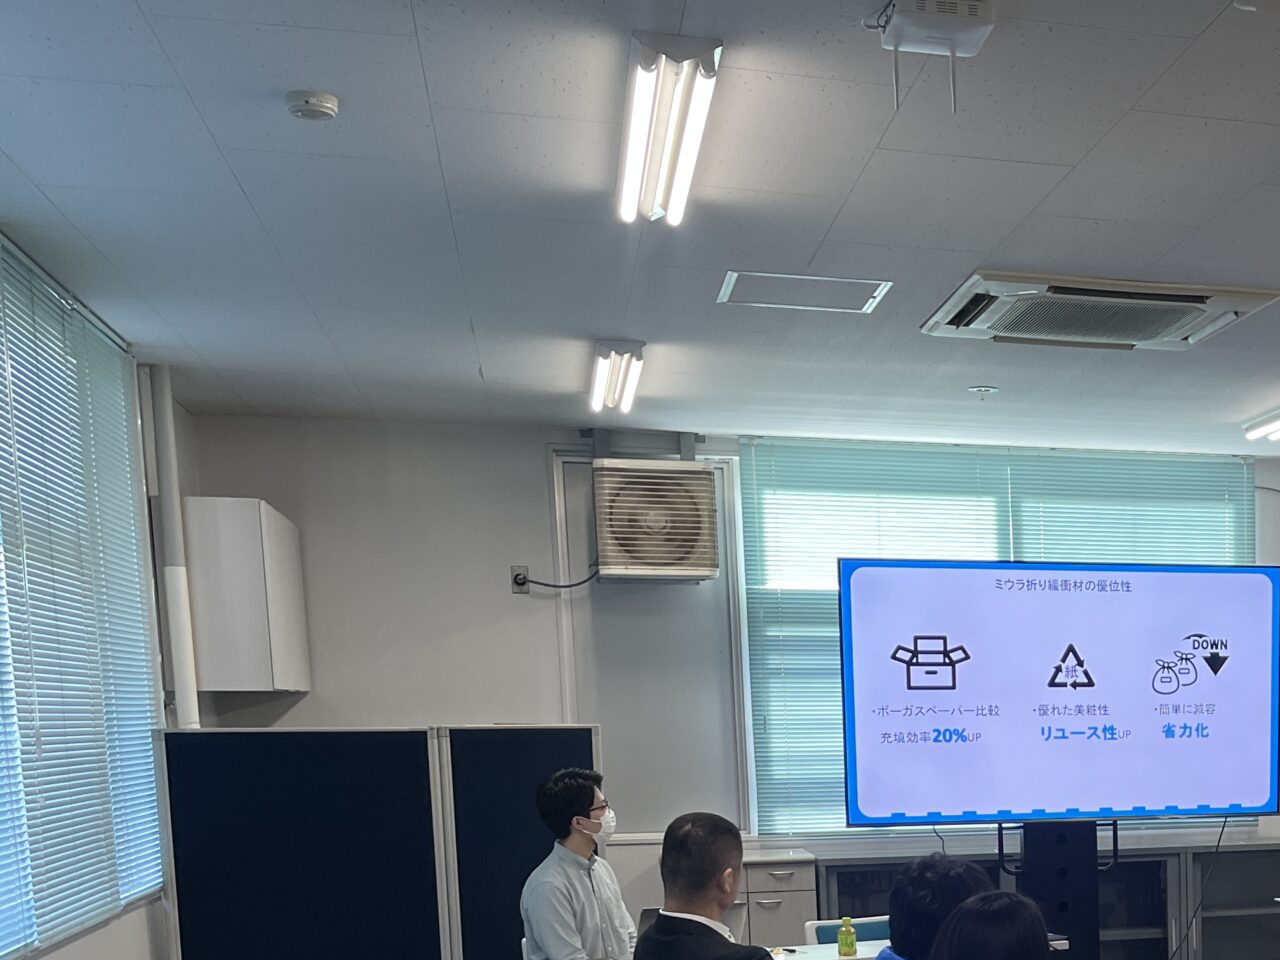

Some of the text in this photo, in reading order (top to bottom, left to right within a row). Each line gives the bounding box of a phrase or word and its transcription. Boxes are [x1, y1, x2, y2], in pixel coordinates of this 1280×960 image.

[995, 578, 1132, 592] ミウラ折り緩衝材の優位性
[1192, 639, 1228, 650] DOWN
[1162, 722, 1209, 739] 省力化
